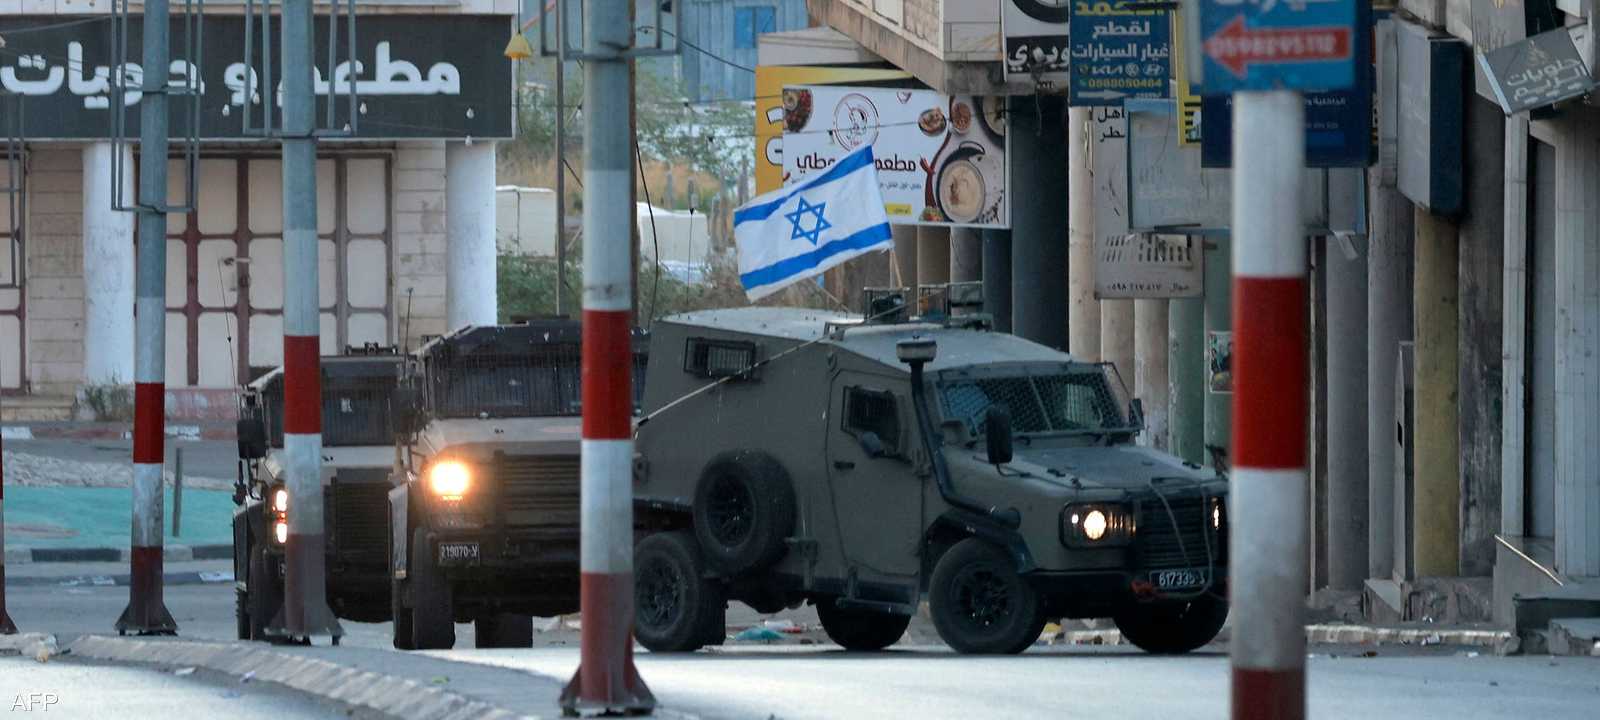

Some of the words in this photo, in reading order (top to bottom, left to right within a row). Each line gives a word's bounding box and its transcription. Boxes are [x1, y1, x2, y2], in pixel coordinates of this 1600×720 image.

[1092, 20, 1150, 39] لقطع
[1072, 44, 1137, 61] السيارات
[1140, 43, 1169, 61] غيار
[0, 41, 206, 110] حويات
[1507, 58, 1581, 87] حلويات
[875, 153, 917, 172] مطعم
